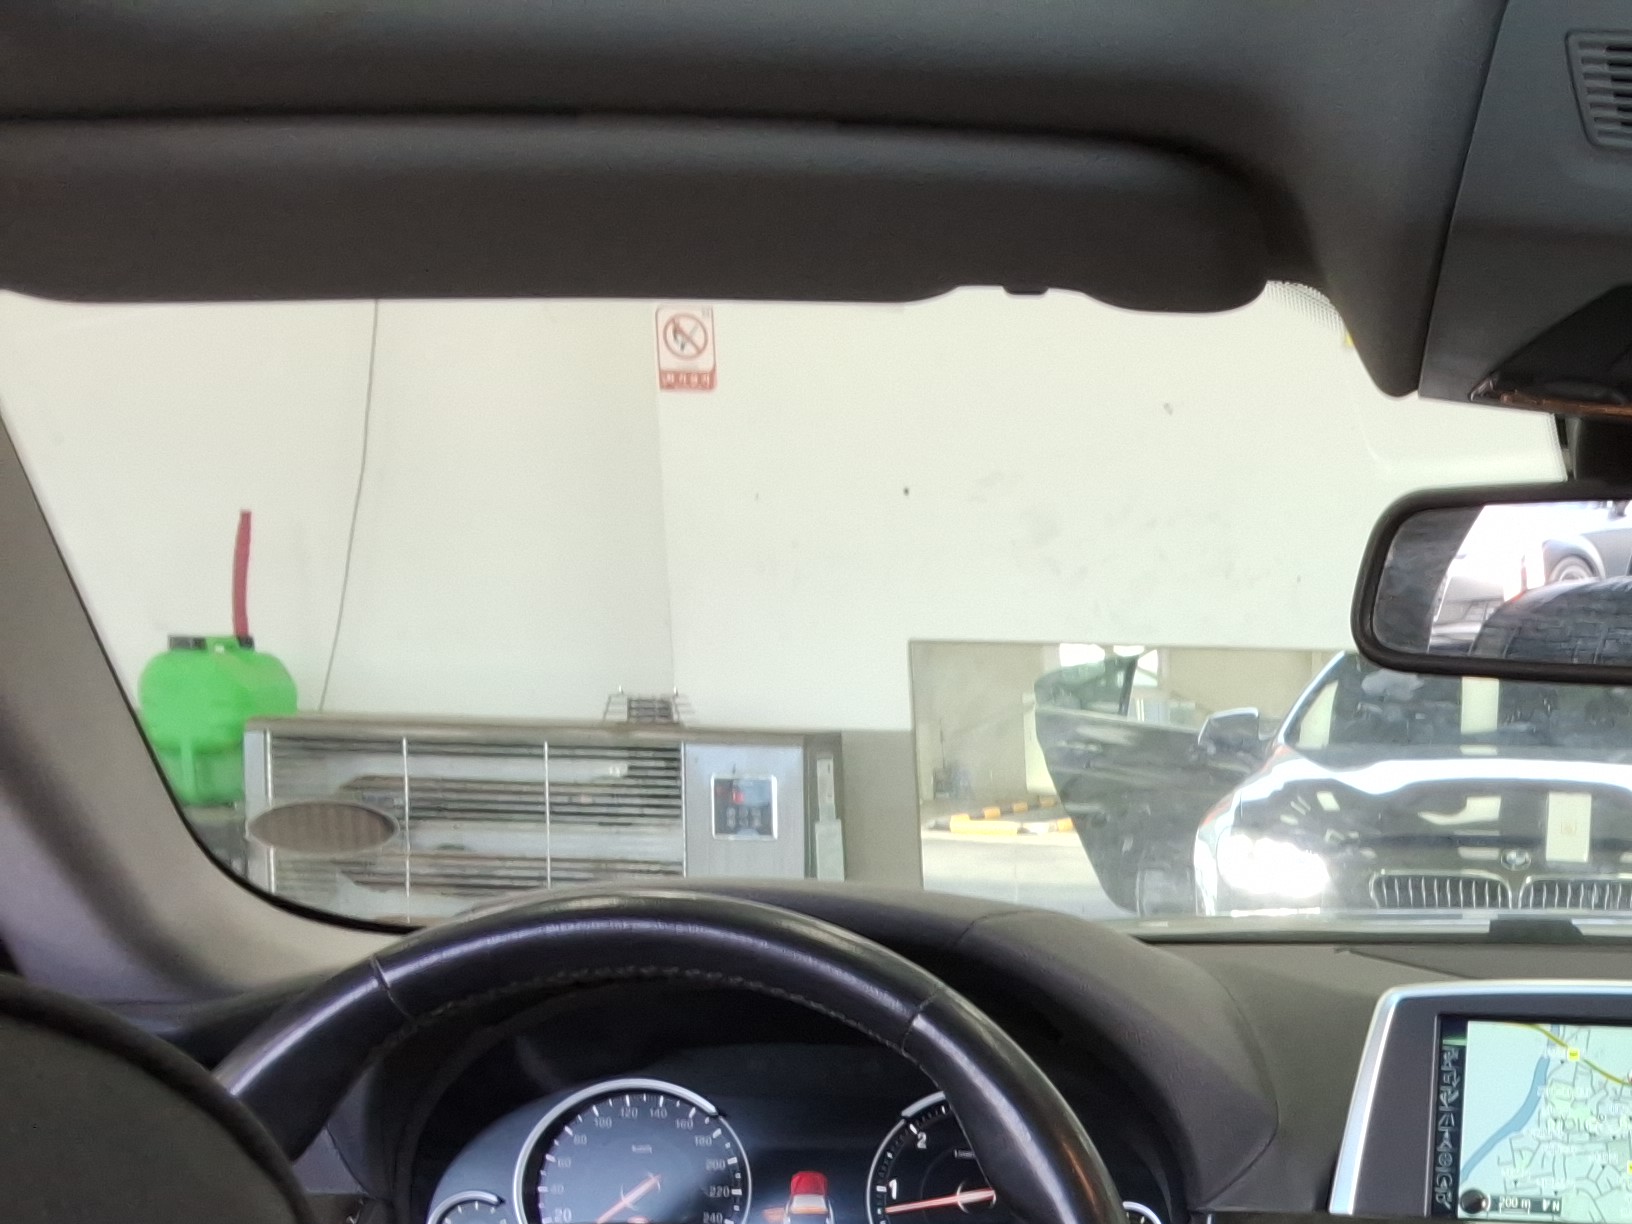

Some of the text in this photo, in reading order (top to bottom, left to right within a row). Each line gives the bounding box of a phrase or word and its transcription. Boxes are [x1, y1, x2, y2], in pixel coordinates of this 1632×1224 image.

[621, 1108, 638, 1118] 120
[650, 1108, 667, 1118] 140
[594, 1118, 612, 1128] 100
[676, 1119, 693, 1129] 160
[573, 1135, 587, 1145] 80
[694, 1136, 713, 1147] 180
[917, 1133, 927, 1149] 2
[557, 1159, 571, 1168] 60
[706, 1160, 726, 1170] 200
[709, 1187, 730, 1197] 220
[889, 1179, 898, 1200] 1
[1521, 1198, 1531, 1209] m
[1552, 1200, 1560, 1211] N
[554, 1208, 572, 1223] 20
[703, 1212, 723, 1224] 240
